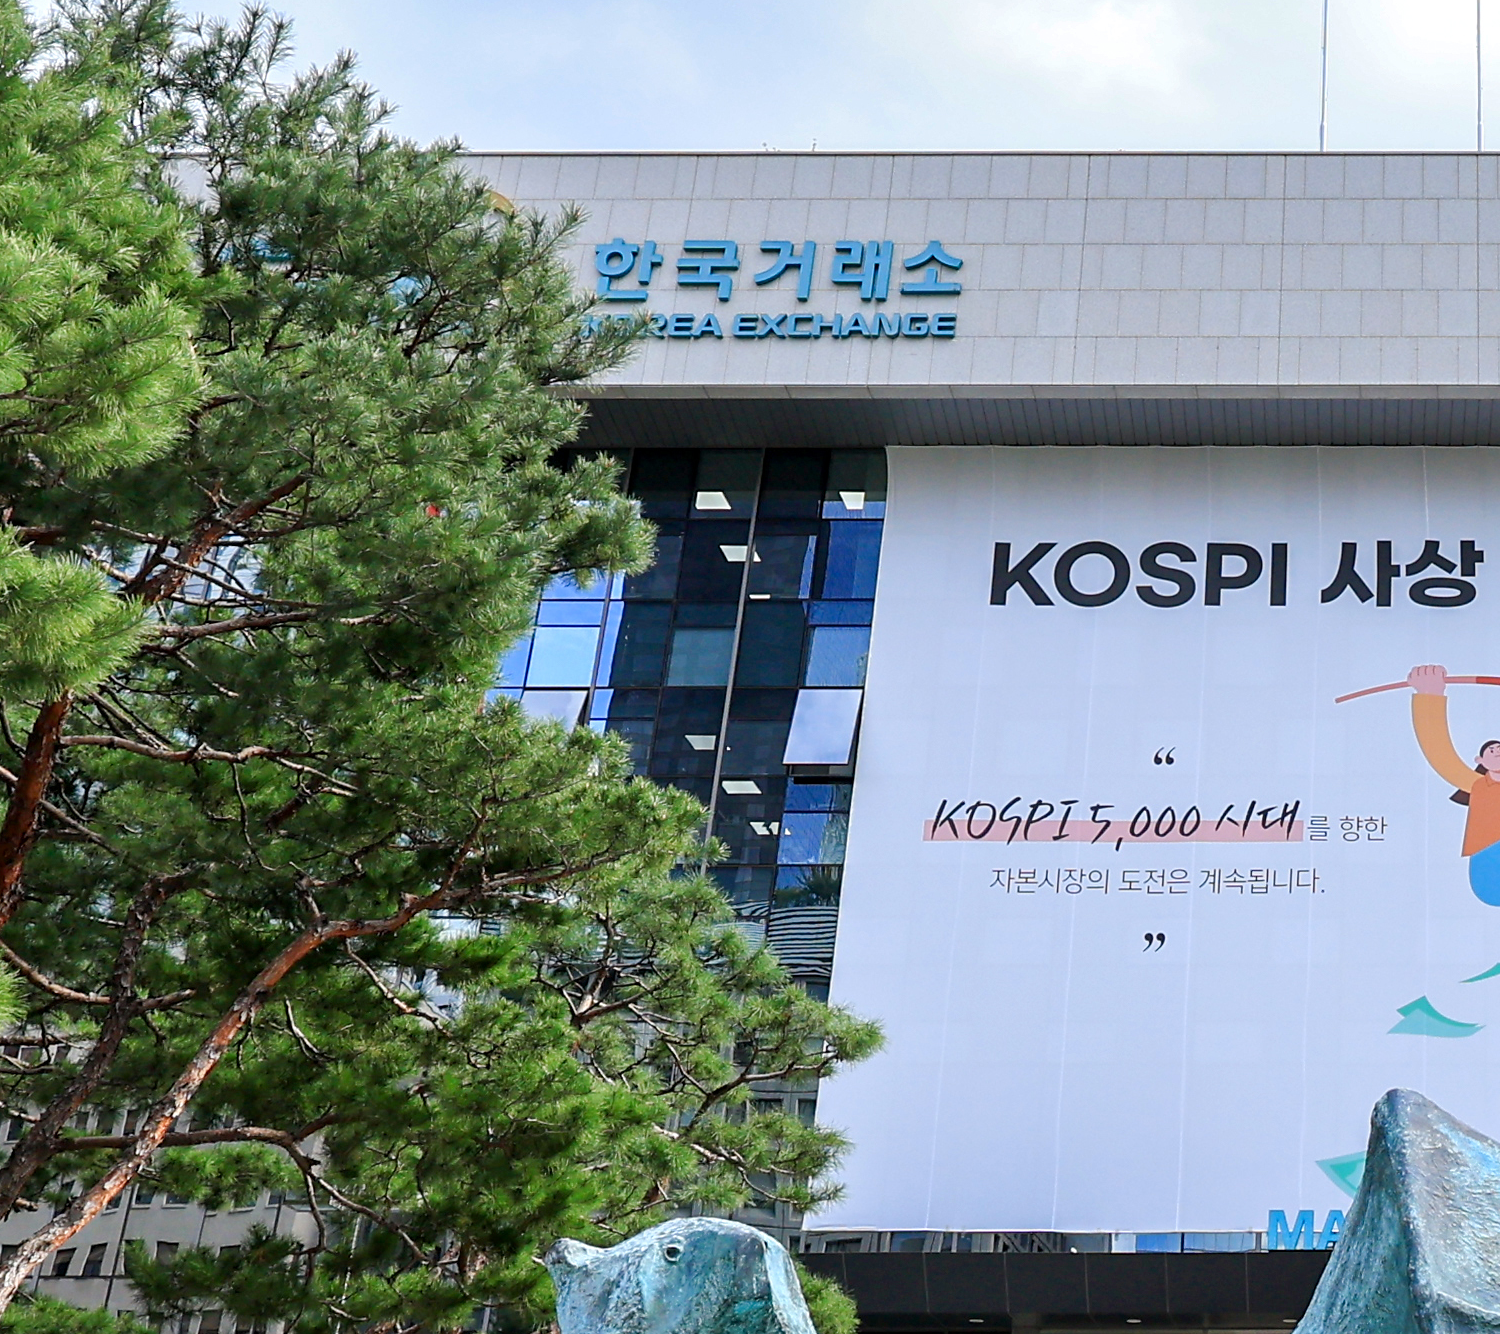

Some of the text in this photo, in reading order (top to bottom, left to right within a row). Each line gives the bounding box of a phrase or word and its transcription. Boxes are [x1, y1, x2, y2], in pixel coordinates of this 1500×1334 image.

[595, 237, 963, 302] 한국거래소
[732, 312, 957, 339] EXCHANGE
[989, 541, 1289, 608] KOSPI
[1320, 540, 1485, 608] 사상
[931, 797, 1080, 846] KOSPI
[1090, 804, 1201, 851] 5,000
[1339, 815, 1389, 842] 향한
[989, 868, 1326, 895] 자본시장의 도전은 계속됩니다.
